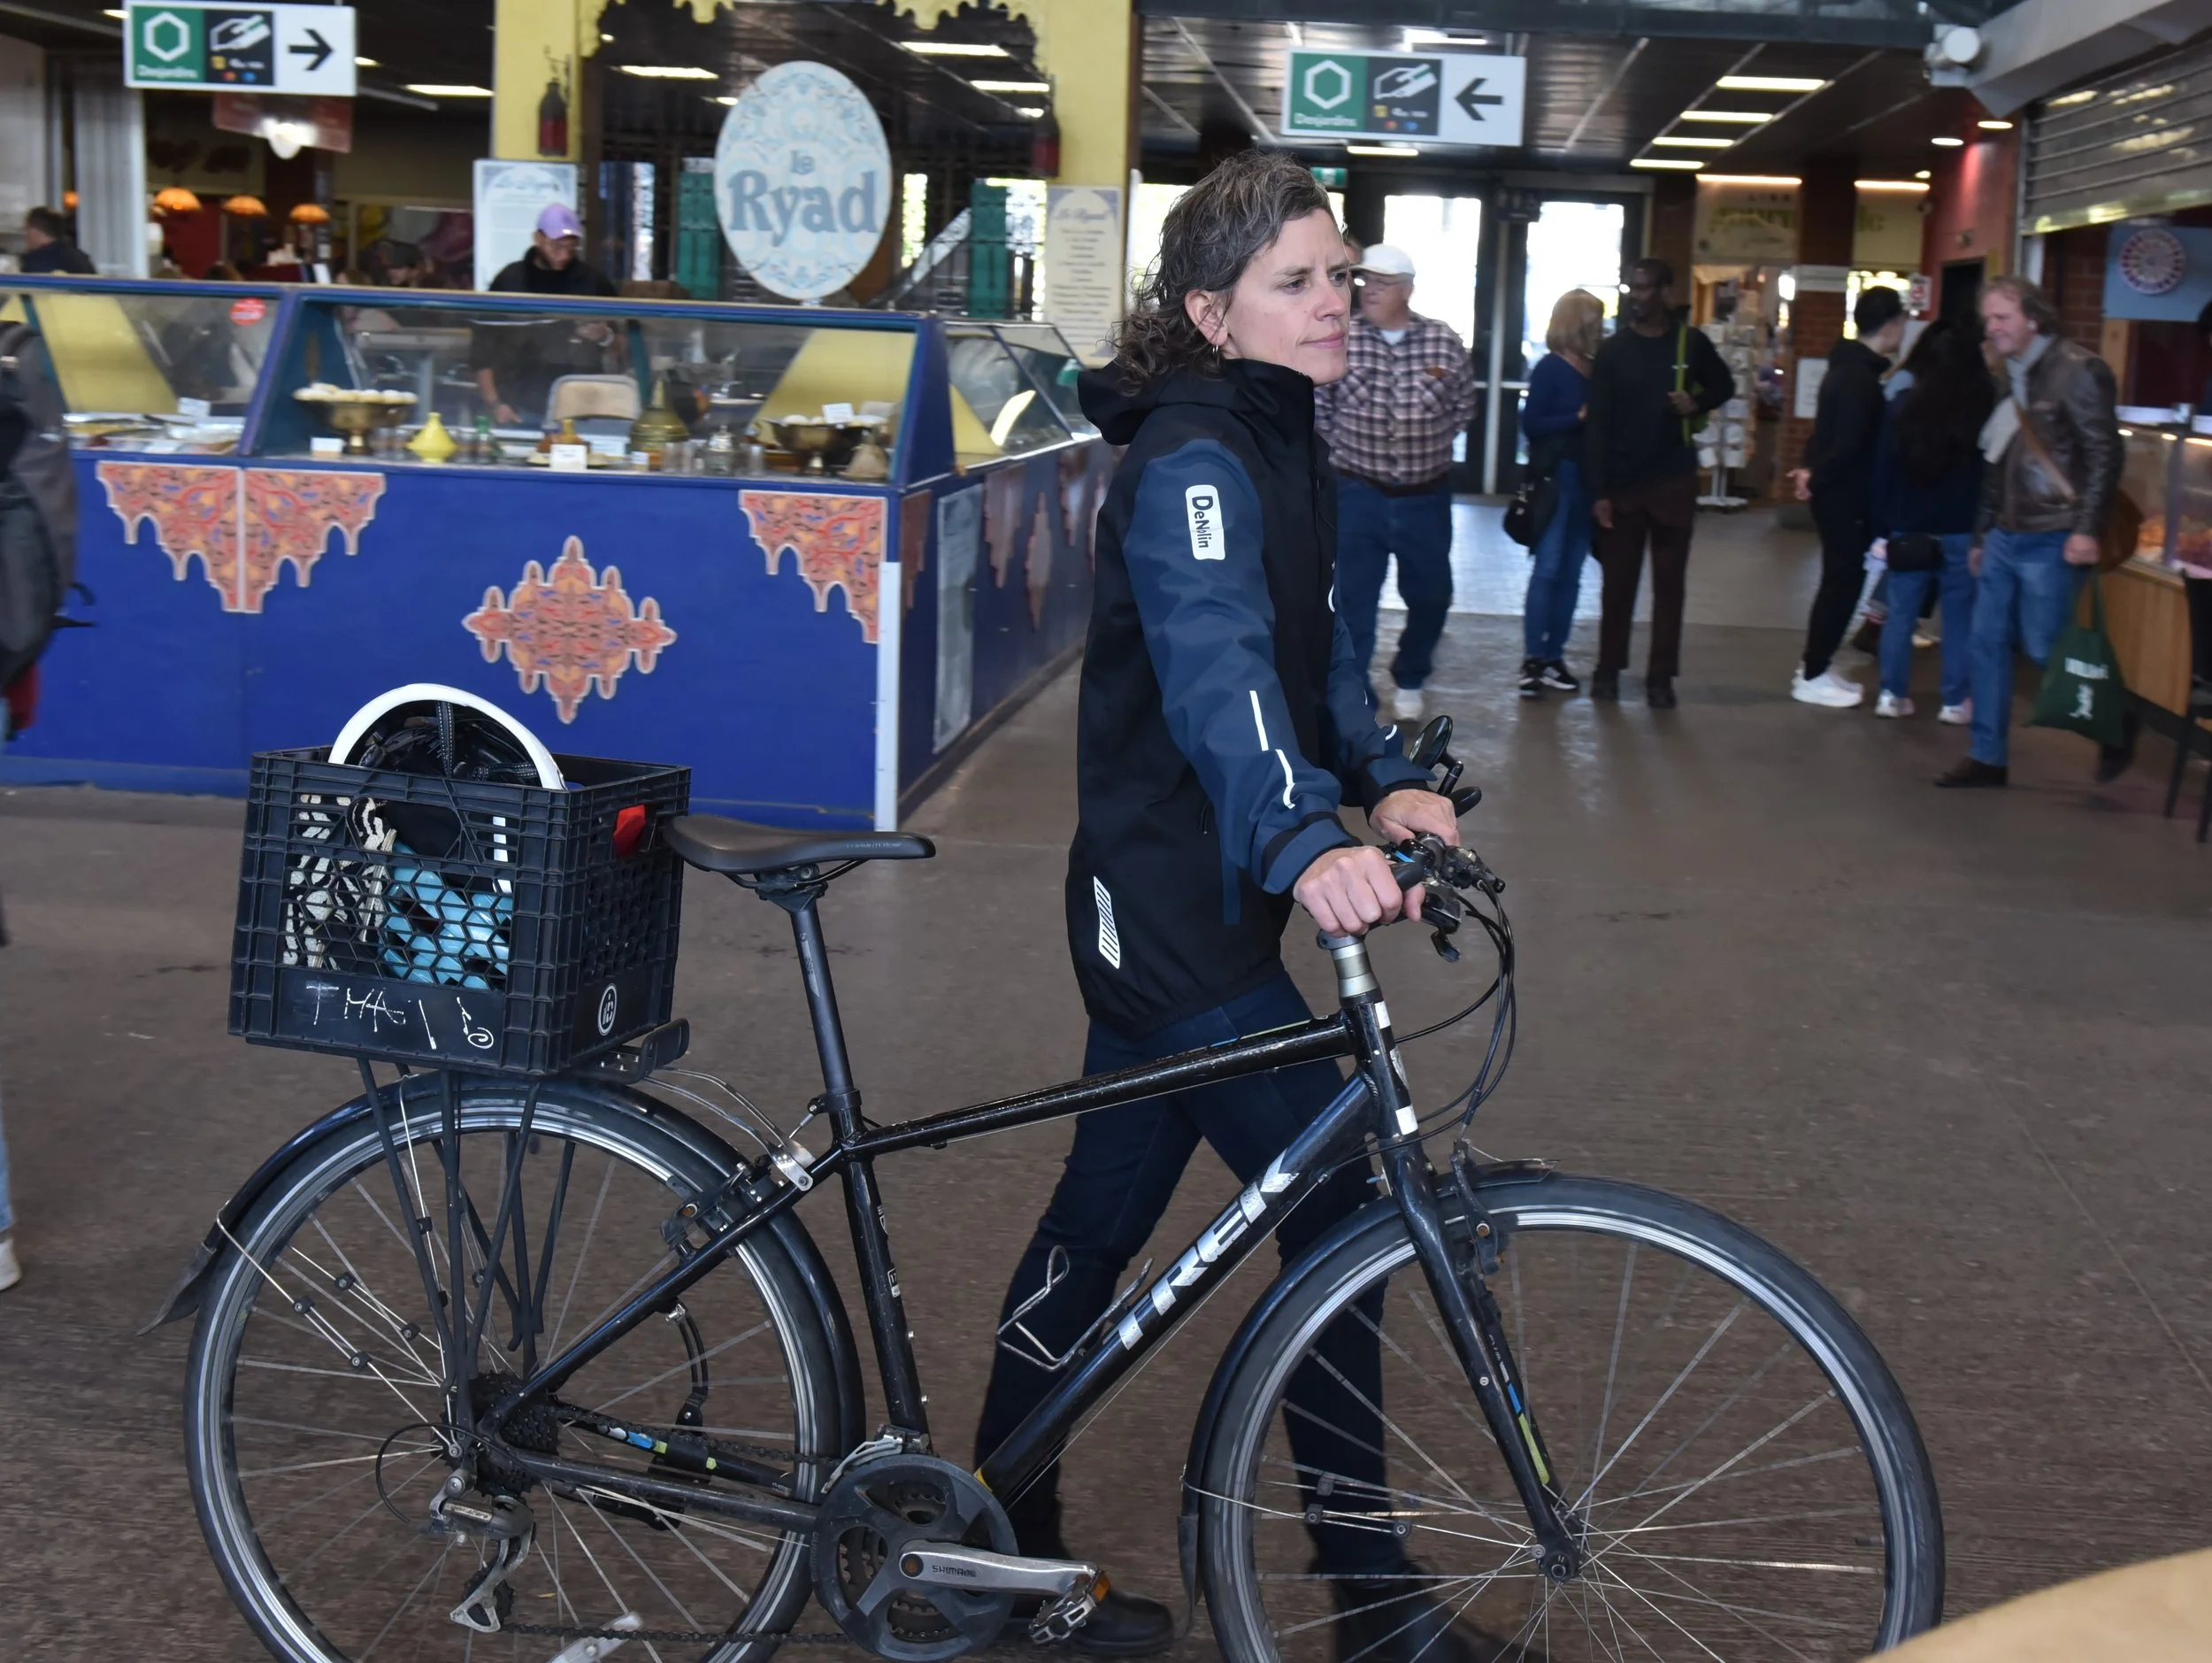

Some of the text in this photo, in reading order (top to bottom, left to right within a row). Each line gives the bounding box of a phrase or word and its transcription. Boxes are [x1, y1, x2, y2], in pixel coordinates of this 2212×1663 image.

[789, 150, 816, 175] le
[726, 169, 879, 247] Ryad
[1102, 1148, 1300, 1351] TREK
